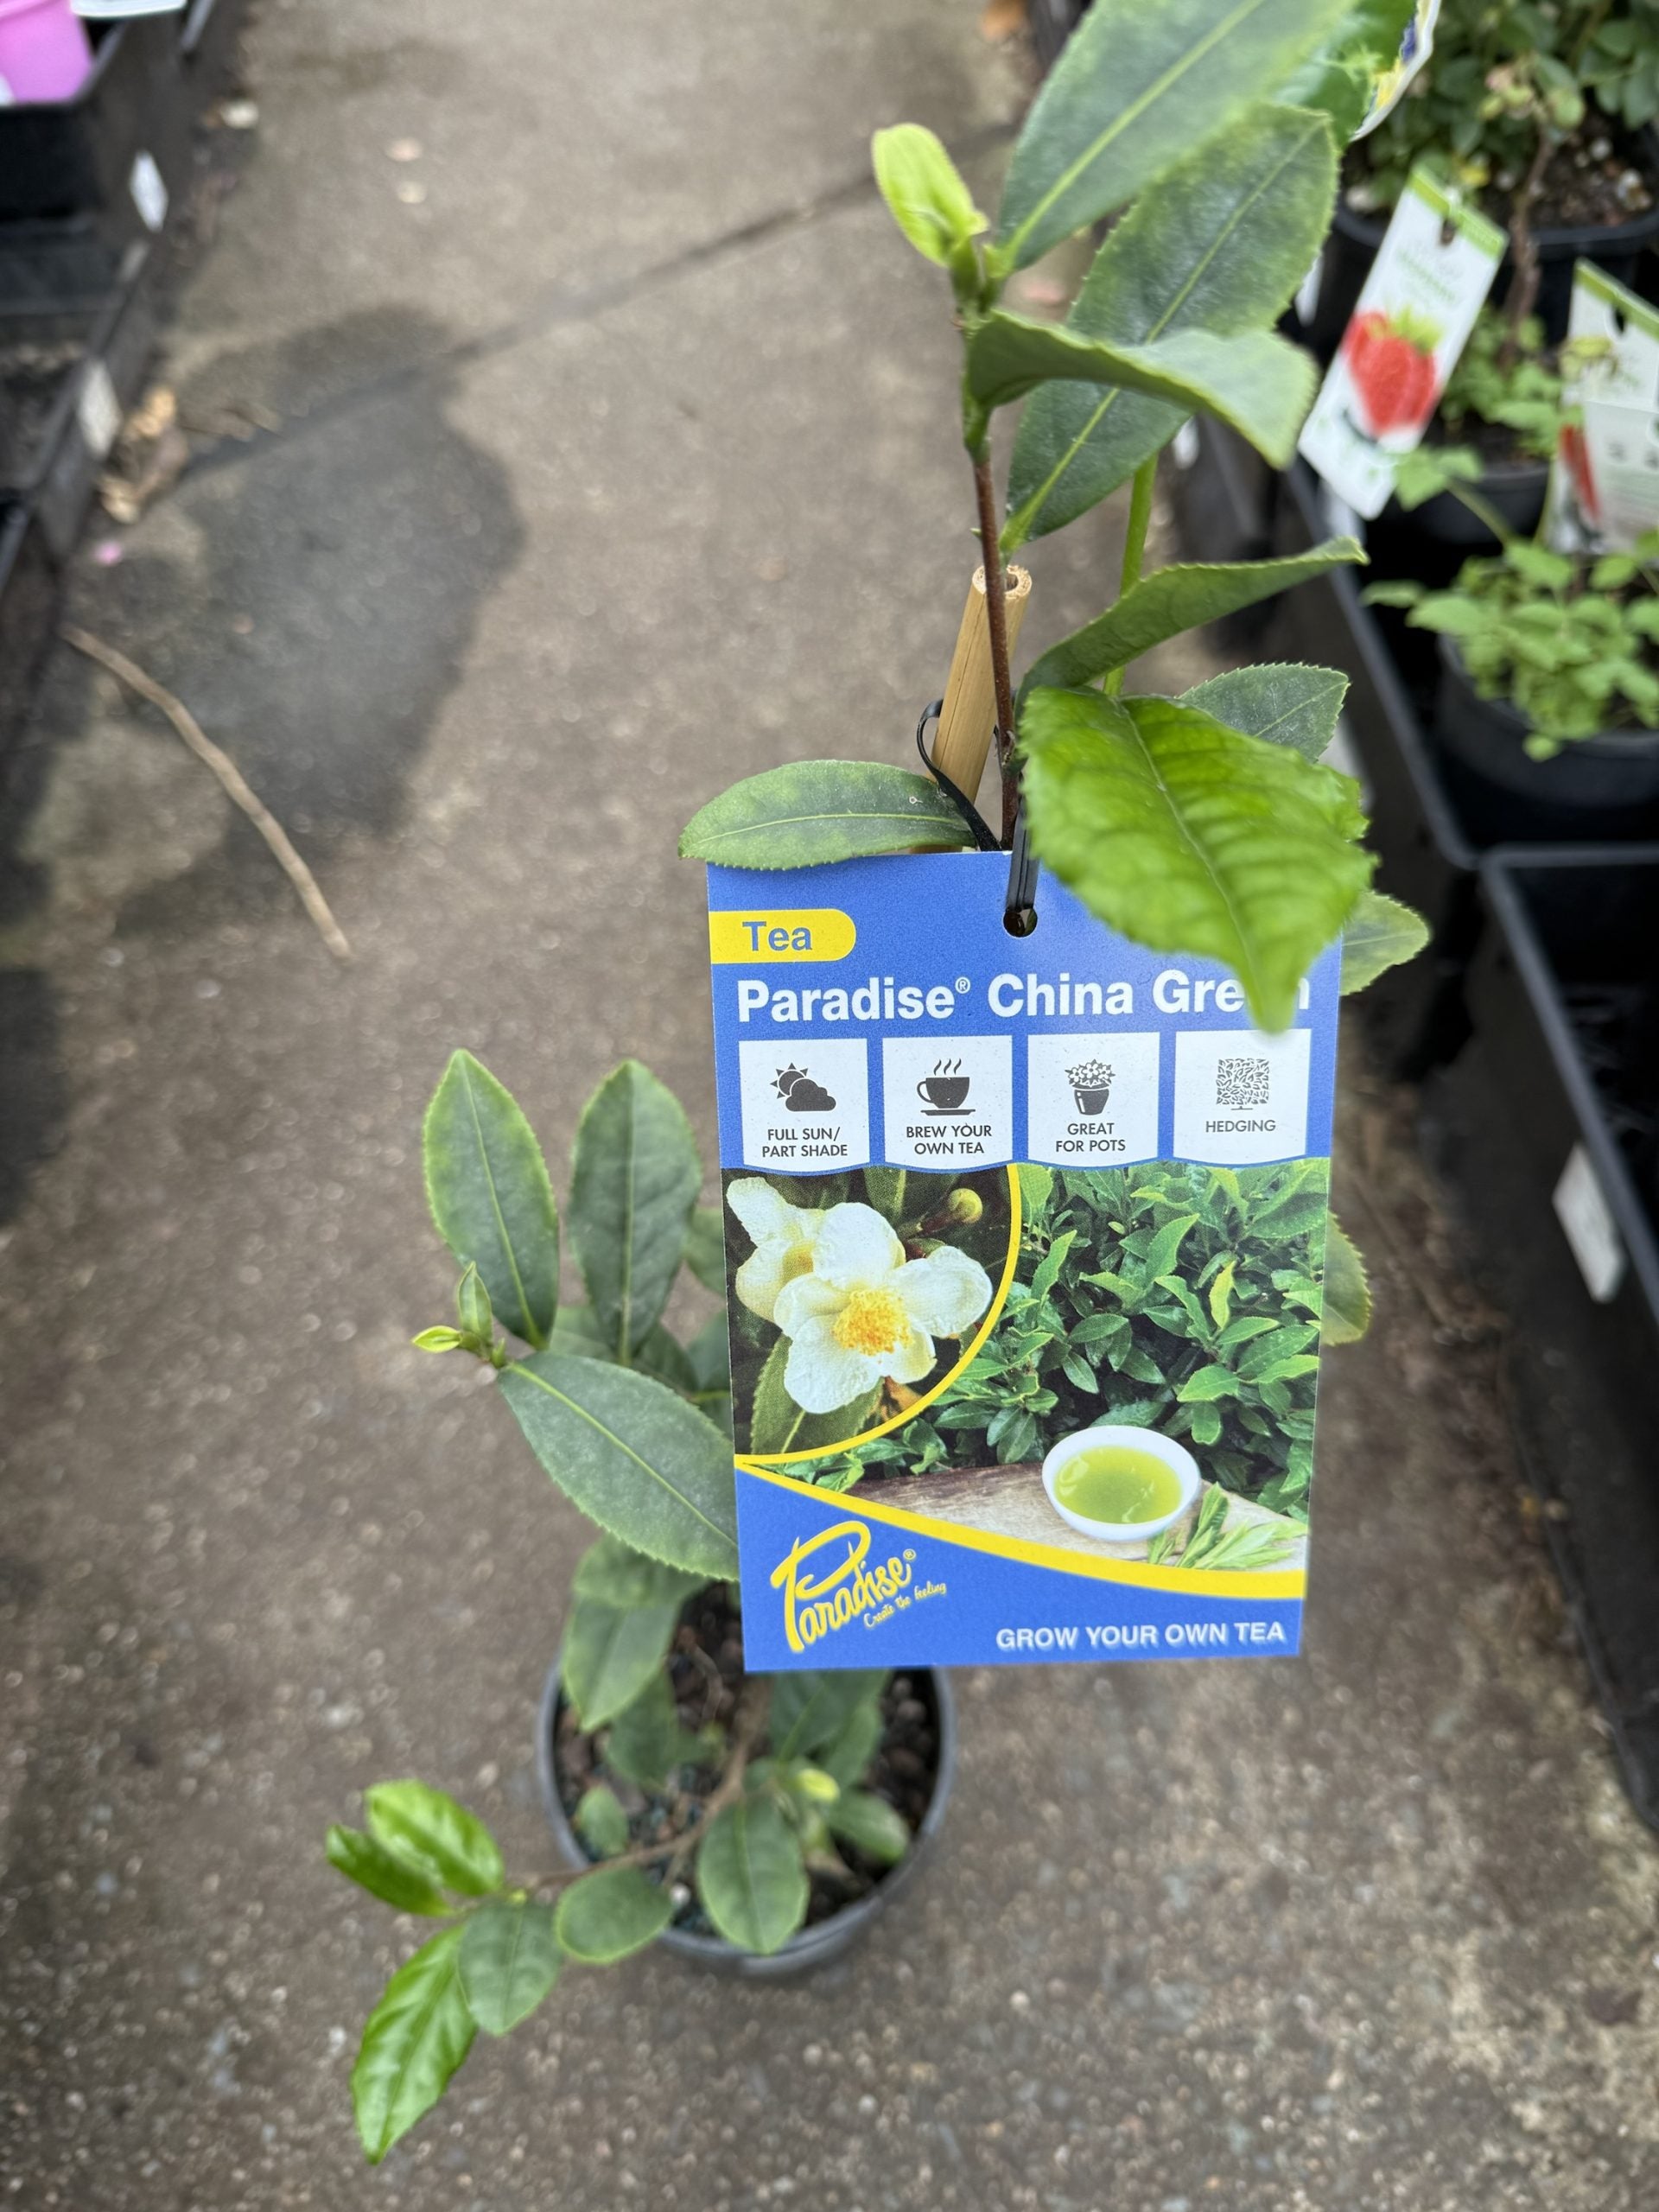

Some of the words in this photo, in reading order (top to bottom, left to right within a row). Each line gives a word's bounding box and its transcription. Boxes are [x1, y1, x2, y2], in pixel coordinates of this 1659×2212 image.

[741, 919, 814, 953] Tea
[987, 972, 1135, 1018] China
[1152, 969, 1311, 1014] Gre
[766, 1128, 798, 1141] FULL
[802, 1125, 841, 1142] SUN/
[906, 1125, 947, 1139] BREW
[950, 1123, 993, 1138] YOUR
[1066, 1122, 1116, 1136] GREAT
[1205, 1119, 1277, 1134] HEDGING
[761, 1145, 798, 1159] PART
[800, 1144, 849, 1158] SHADE
[913, 1141, 954, 1156] OWN
[957, 1141, 985, 1155] TEA
[1055, 1140, 1085, 1154] FOR
[1089, 1138, 1127, 1153] POTS
[913, 1580, 947, 1600] feeling
[995, 1626, 1079, 1650] GROW
[1085, 1624, 1159, 1647] YOUR
[1164, 1623, 1228, 1645] OWN
[1234, 1620, 1287, 1643] TEA
